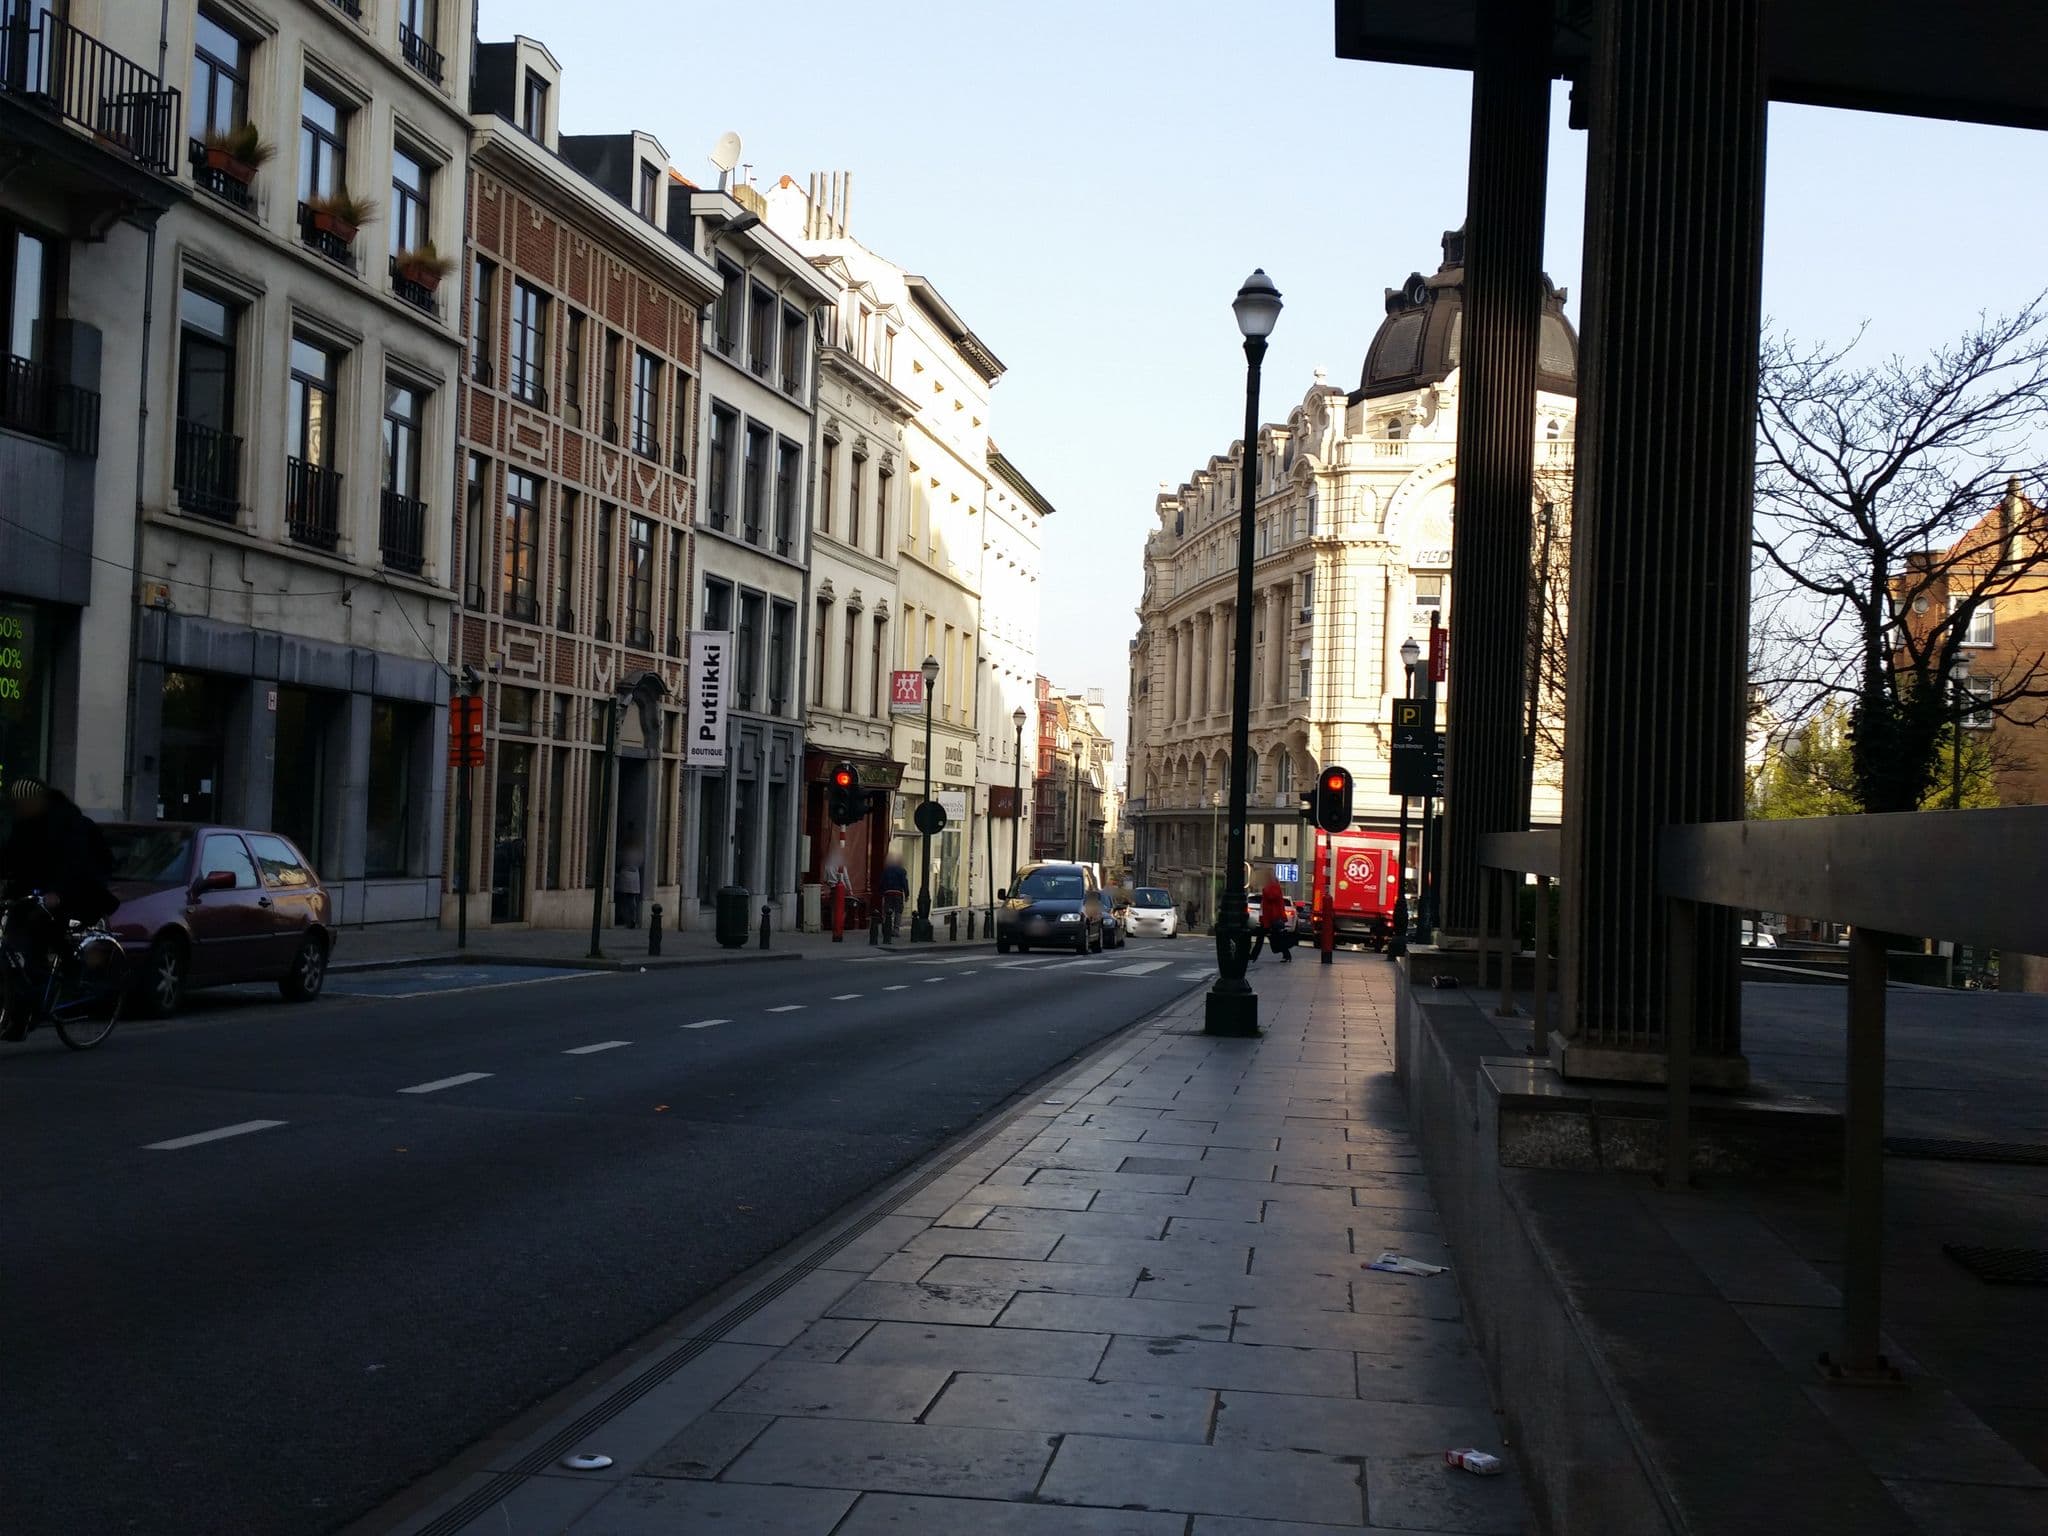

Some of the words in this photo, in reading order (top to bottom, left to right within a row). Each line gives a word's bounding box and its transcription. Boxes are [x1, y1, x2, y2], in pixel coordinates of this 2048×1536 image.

[0, 648, 22, 669] 0%
[0, 677, 20, 700] 0%
[700, 645, 721, 740] Putiikki
[1403, 708, 1416, 724] P
[691, 747, 723, 756] BOUTIQUE
[1348, 863, 1369, 878] 80
